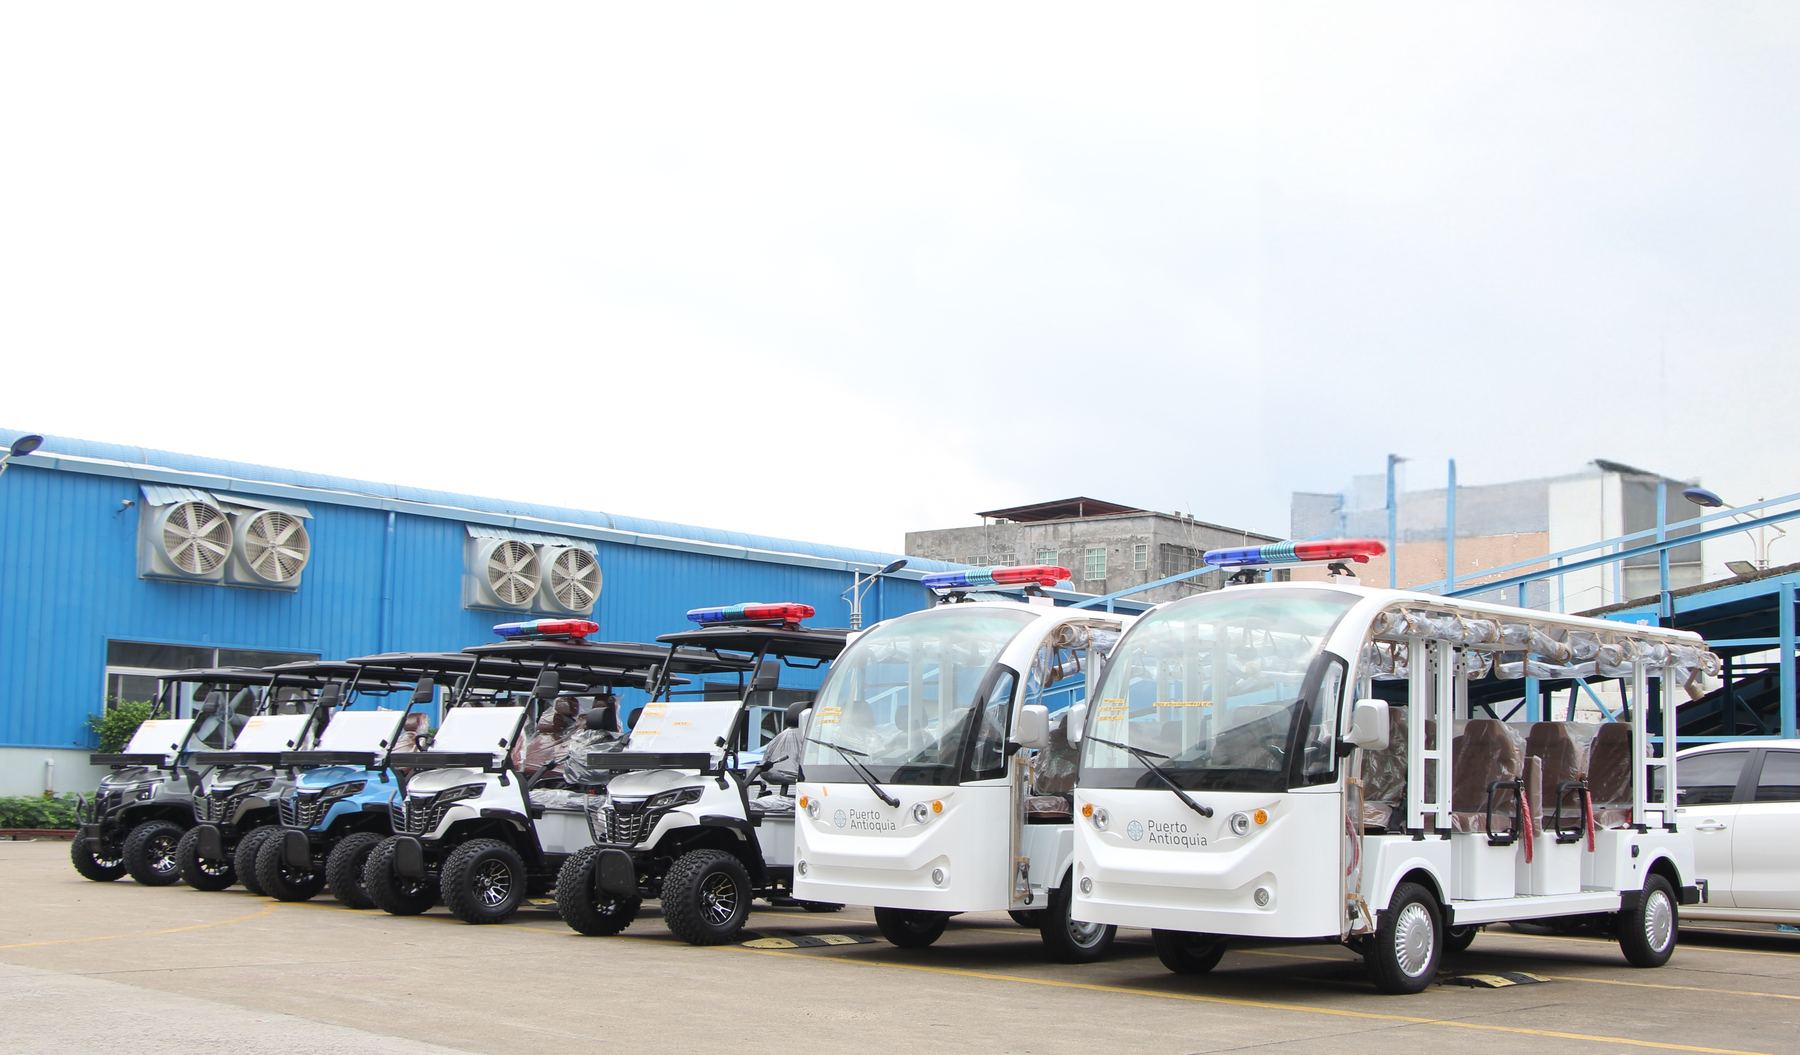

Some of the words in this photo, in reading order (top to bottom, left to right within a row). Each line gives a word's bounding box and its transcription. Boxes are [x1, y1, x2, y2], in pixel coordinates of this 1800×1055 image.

[849, 808, 881, 820] Puerto
[850, 819, 896, 833] Antioquia
[1147, 819, 1188, 834] Puerto
[1148, 832, 1208, 849] Antioquia
